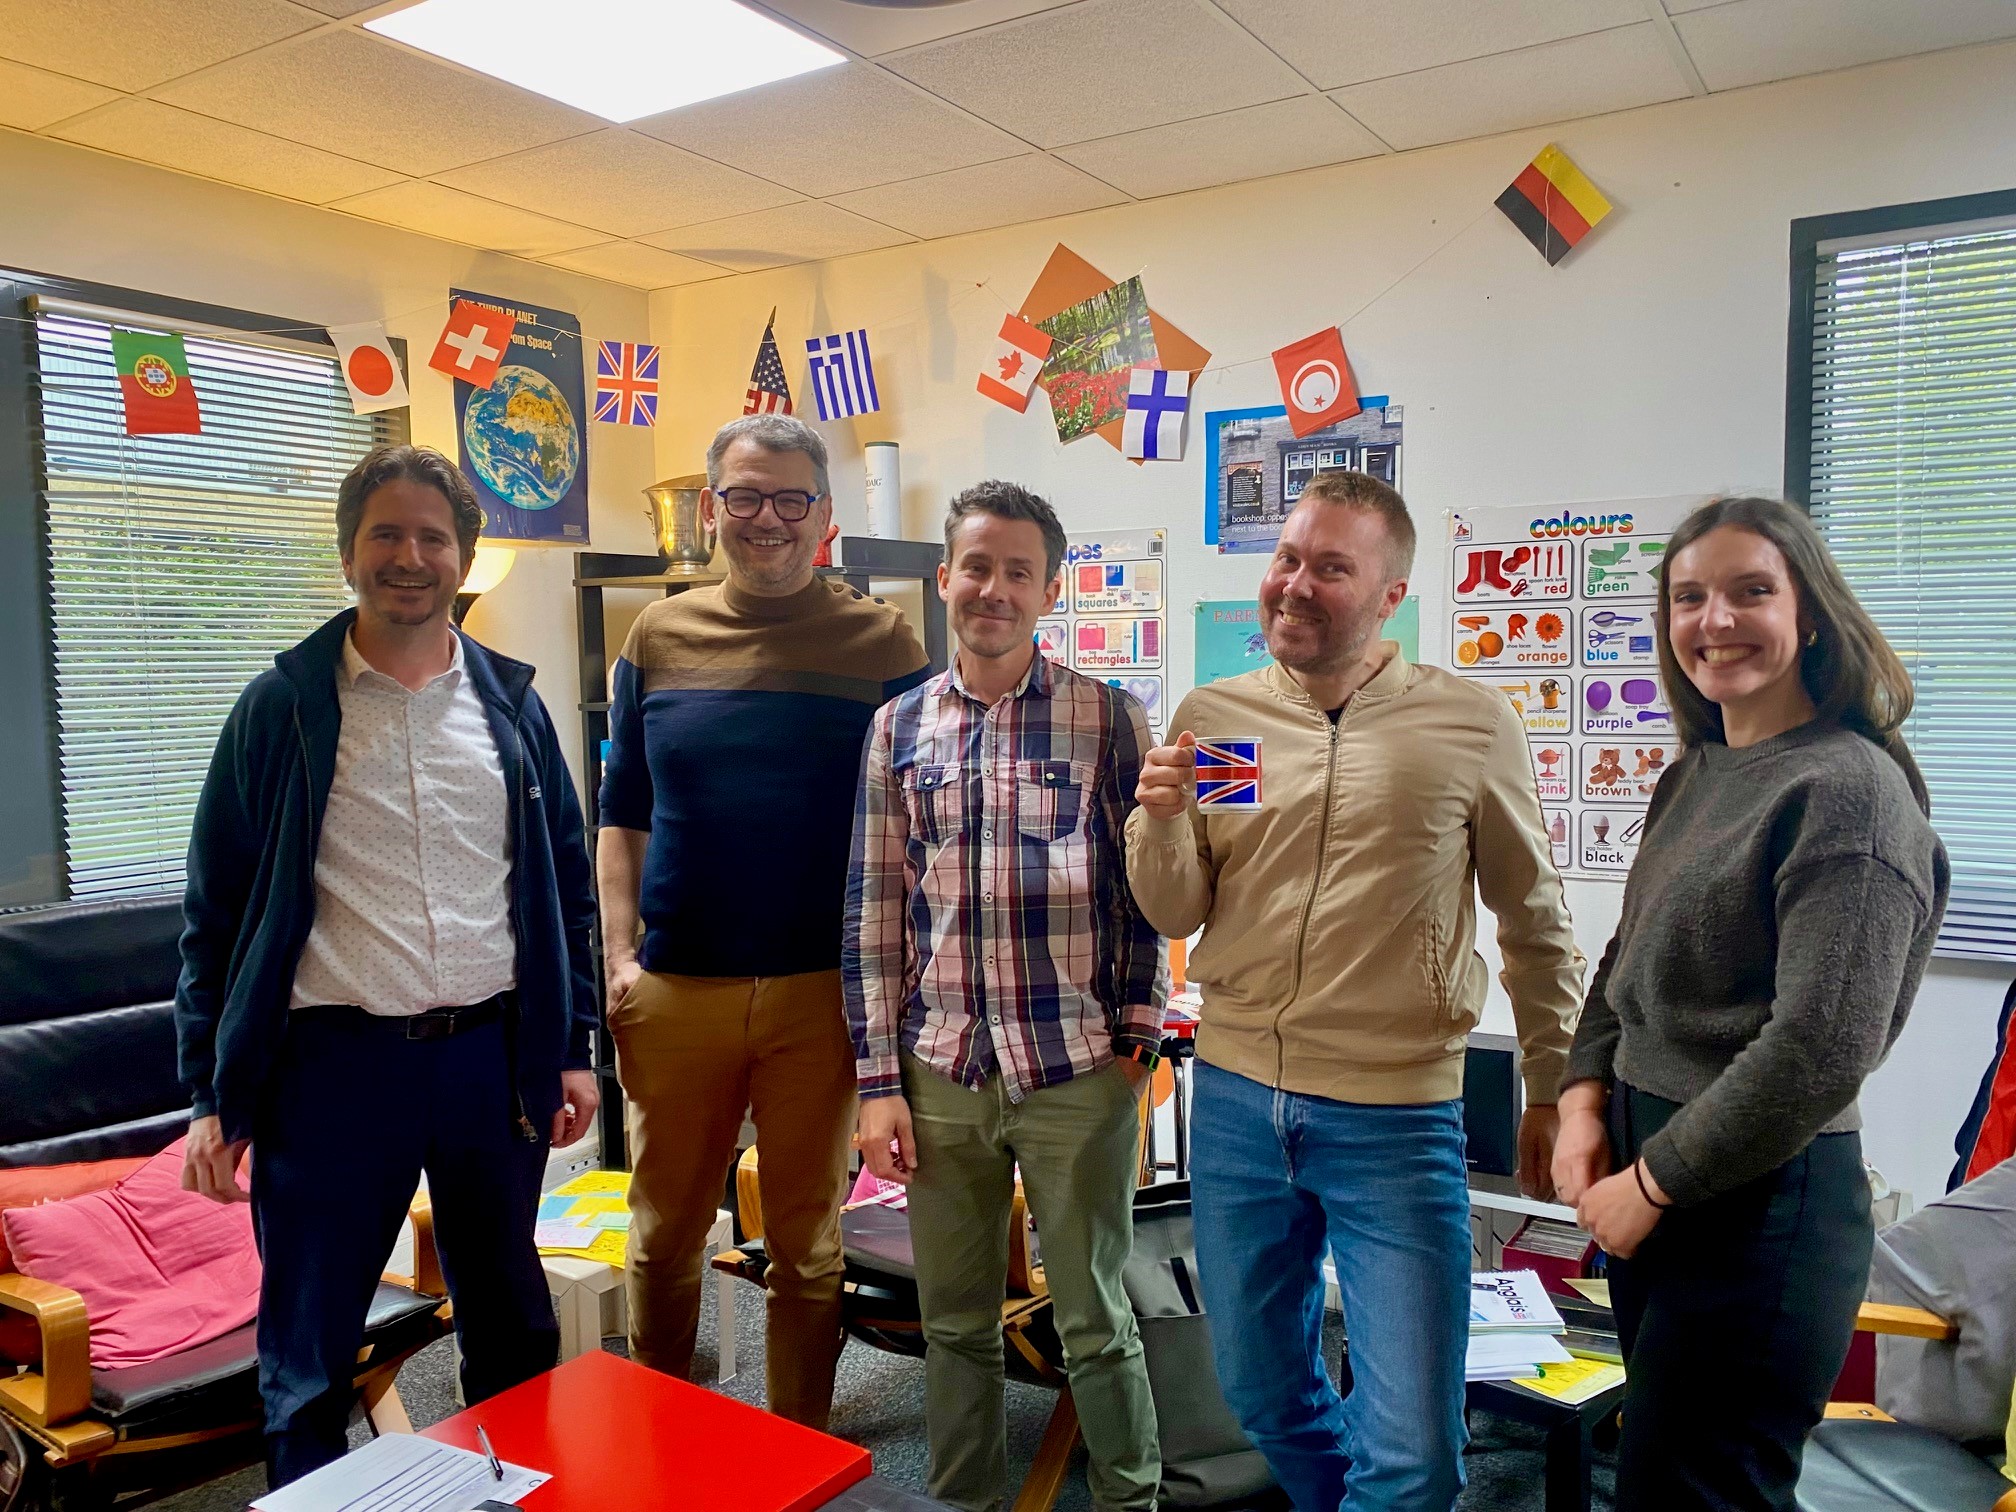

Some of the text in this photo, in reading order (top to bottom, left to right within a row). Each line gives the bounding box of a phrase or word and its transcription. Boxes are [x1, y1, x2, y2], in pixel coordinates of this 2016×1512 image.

[526, 334, 553, 351] Space
[1529, 510, 1634, 539] colours
[1544, 582, 1568, 595] red
[1587, 582, 1630, 596] green
[1078, 598, 1118, 610] squares
[1078, 654, 1131, 666] rectangles
[1517, 652, 1568, 664] orange
[1587, 649, 1618, 661] blue
[1587, 717, 1633, 731] purple
[1586, 784, 1631, 796] brown
[1586, 851, 1624, 863] black
[1495, 1278, 1529, 1313] Anglais
